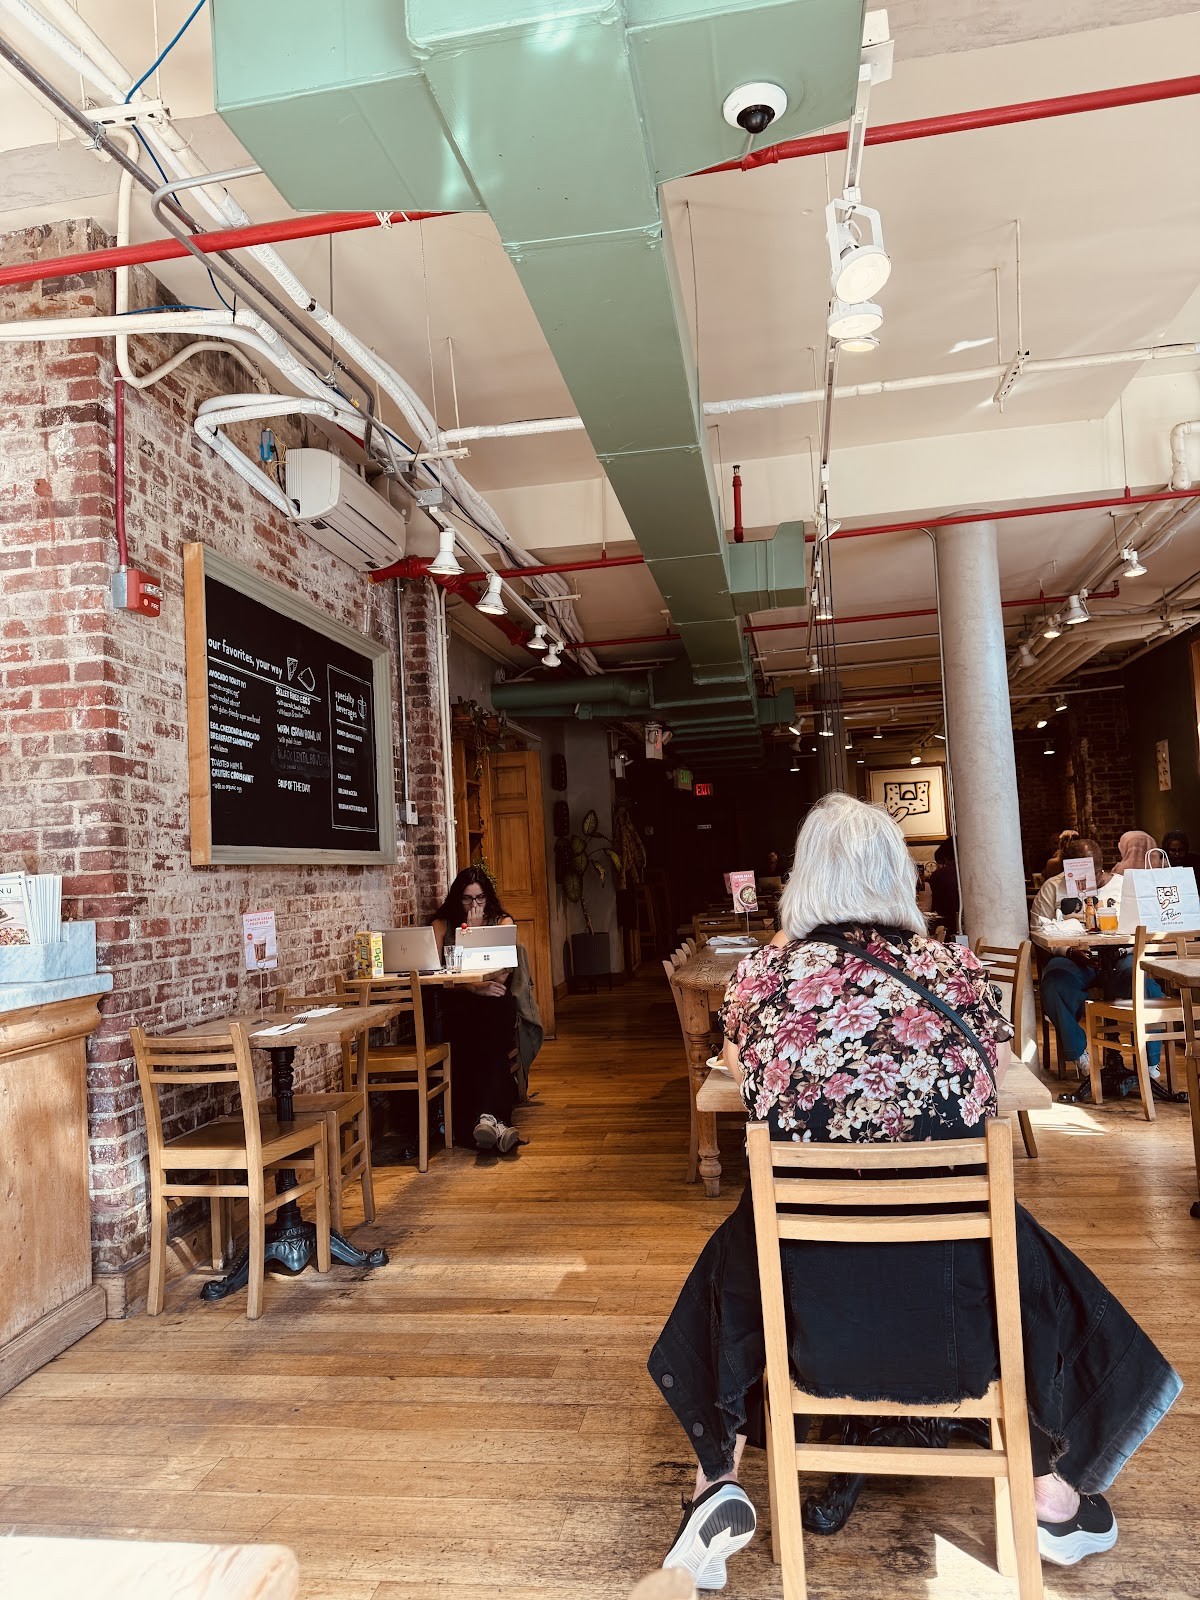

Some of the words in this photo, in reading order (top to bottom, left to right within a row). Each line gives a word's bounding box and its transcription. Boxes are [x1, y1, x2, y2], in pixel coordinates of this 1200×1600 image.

[150, 602, 159, 610] FIRE
[208, 638, 221, 650] our
[222, 639, 255, 667] favorites,
[255, 658, 270, 671] your
[271, 664, 283, 680] way
[208, 669, 229, 683] AVOCADO
[335, 691, 355, 708] specialty
[336, 700, 358, 721] beverages
[292, 780, 302, 792] THE
[695, 784, 711, 795] EXIT
